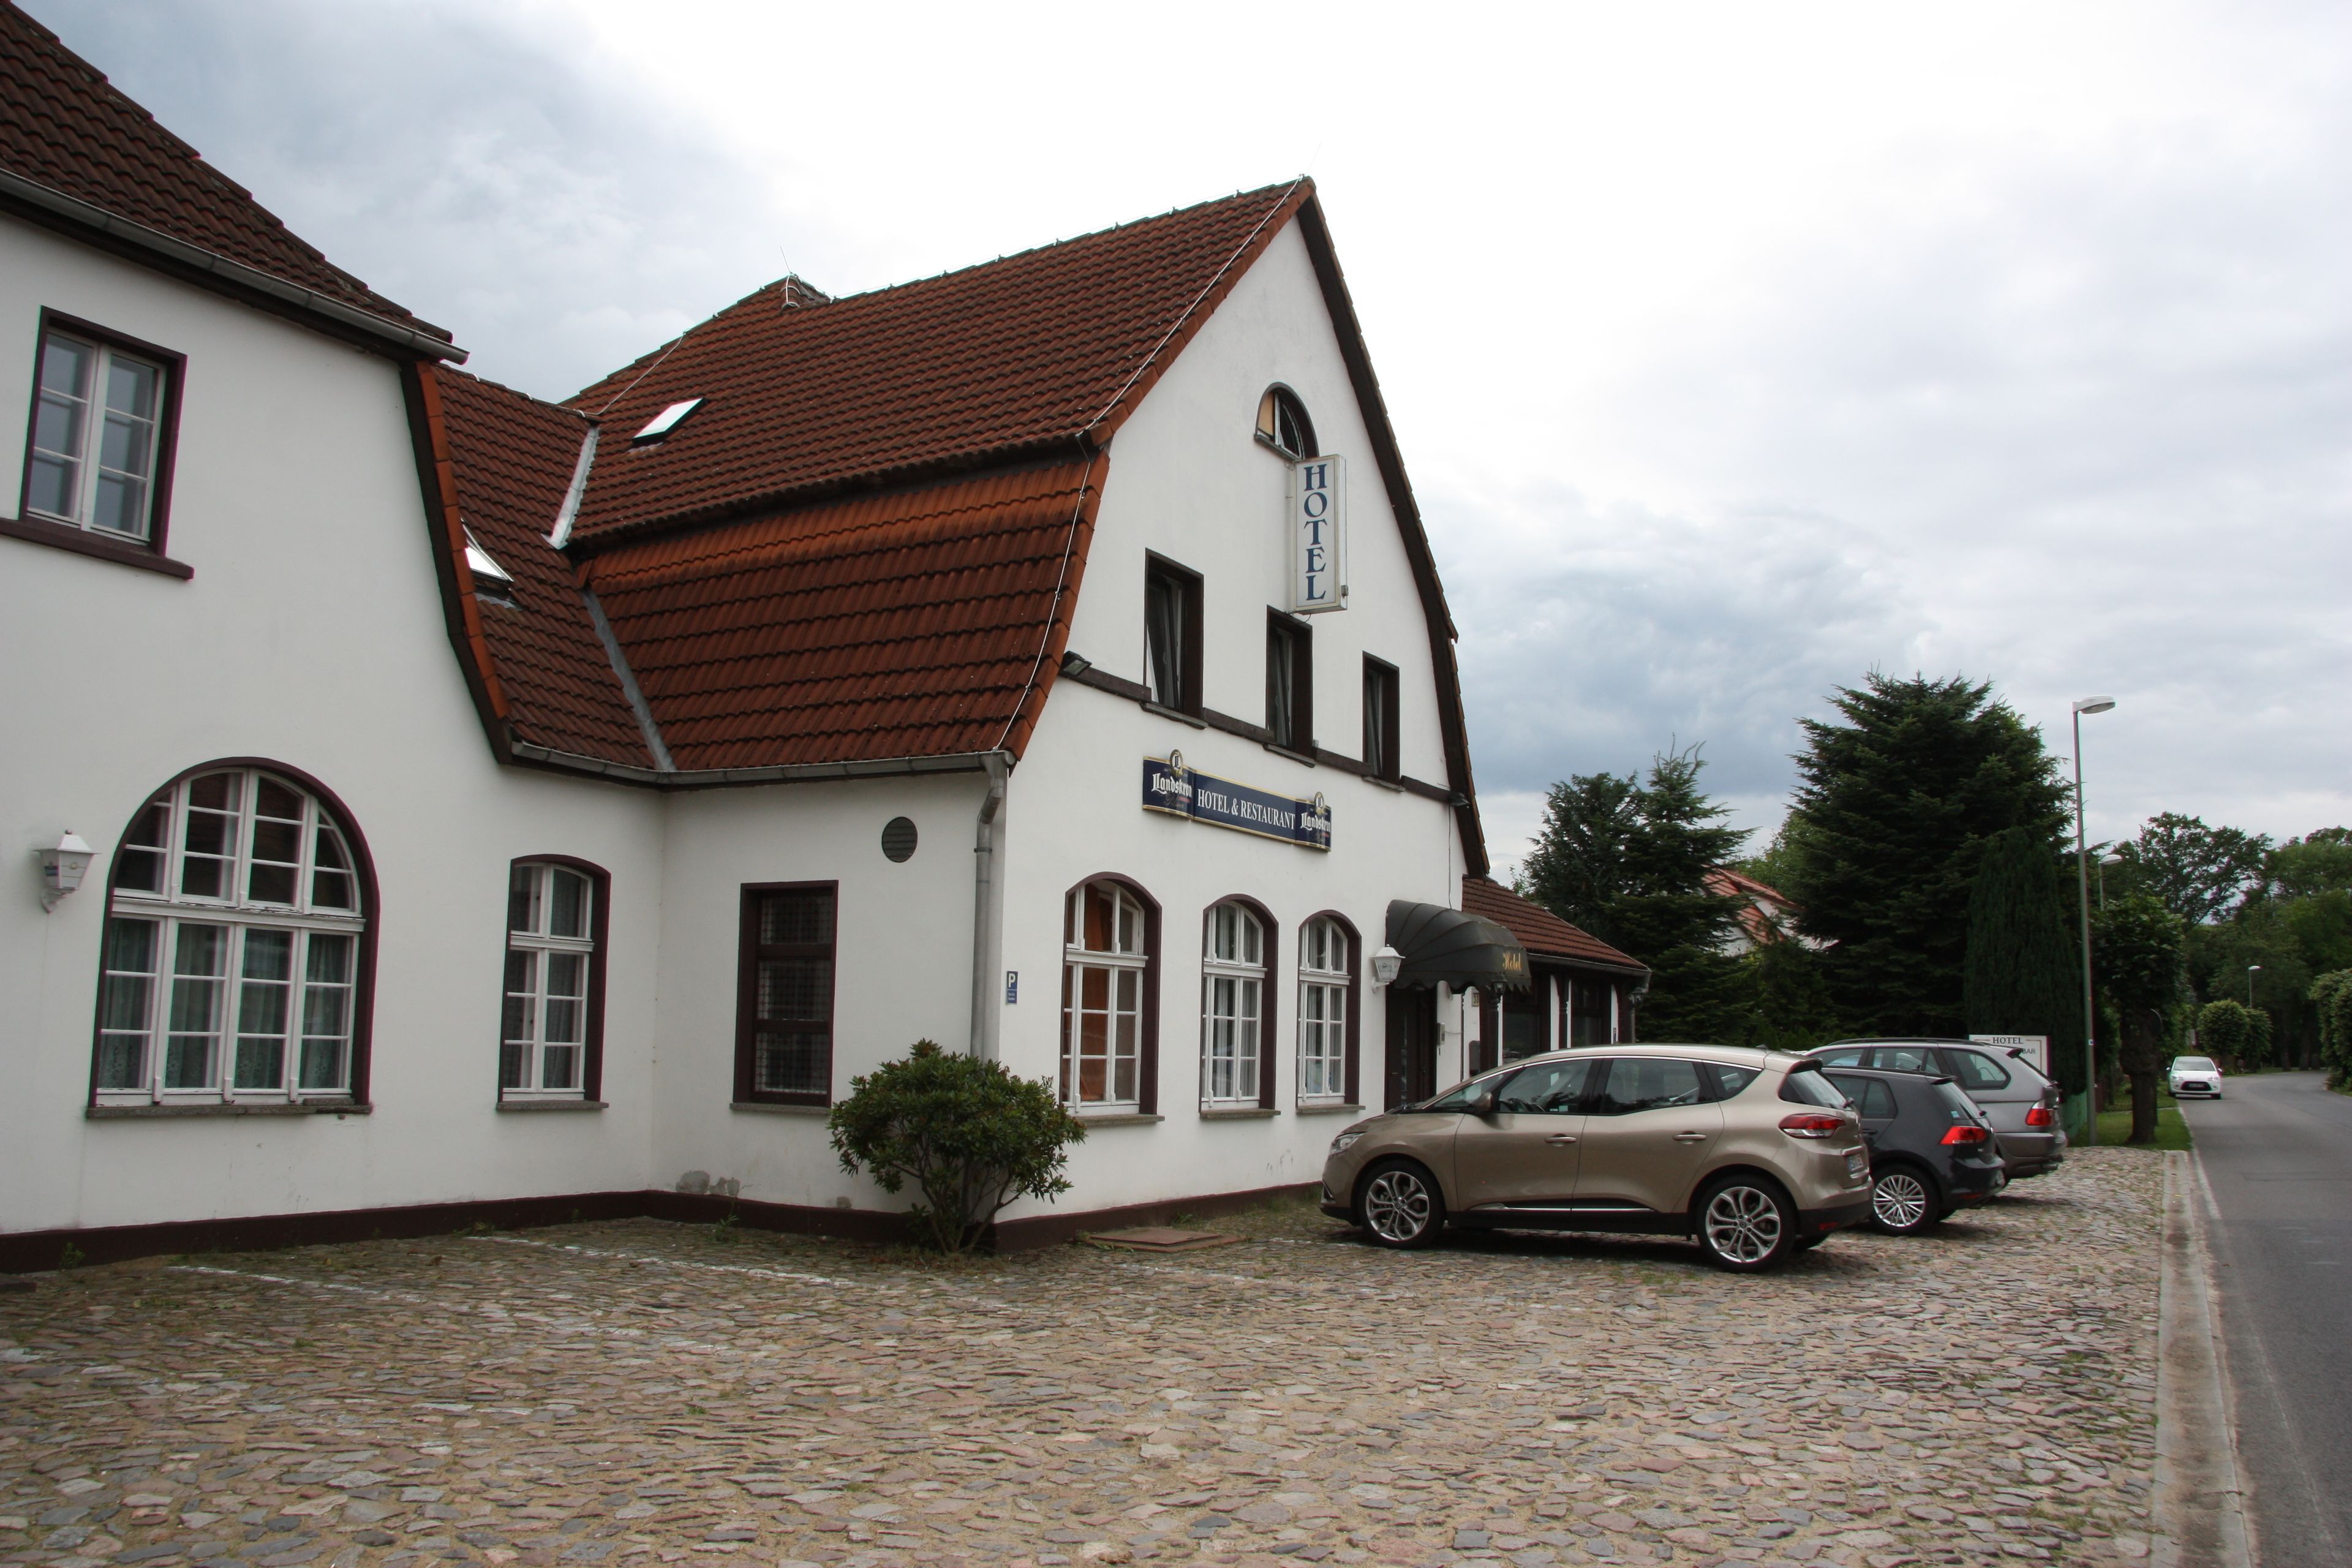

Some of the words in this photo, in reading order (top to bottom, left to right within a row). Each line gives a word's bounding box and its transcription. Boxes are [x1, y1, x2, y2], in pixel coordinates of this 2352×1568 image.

[1303, 464, 1328, 601] HOTEL
[1151, 772, 1192, 797] Landskron
[1197, 788, 1229, 814] HOTEL
[1231, 798, 1238, 816] &
[1240, 799, 1295, 830] RESTAURANT
[1300, 812, 1331, 833] Landskron
[1502, 952, 1522, 971] Hotel
[1008, 973, 1016, 987] P
